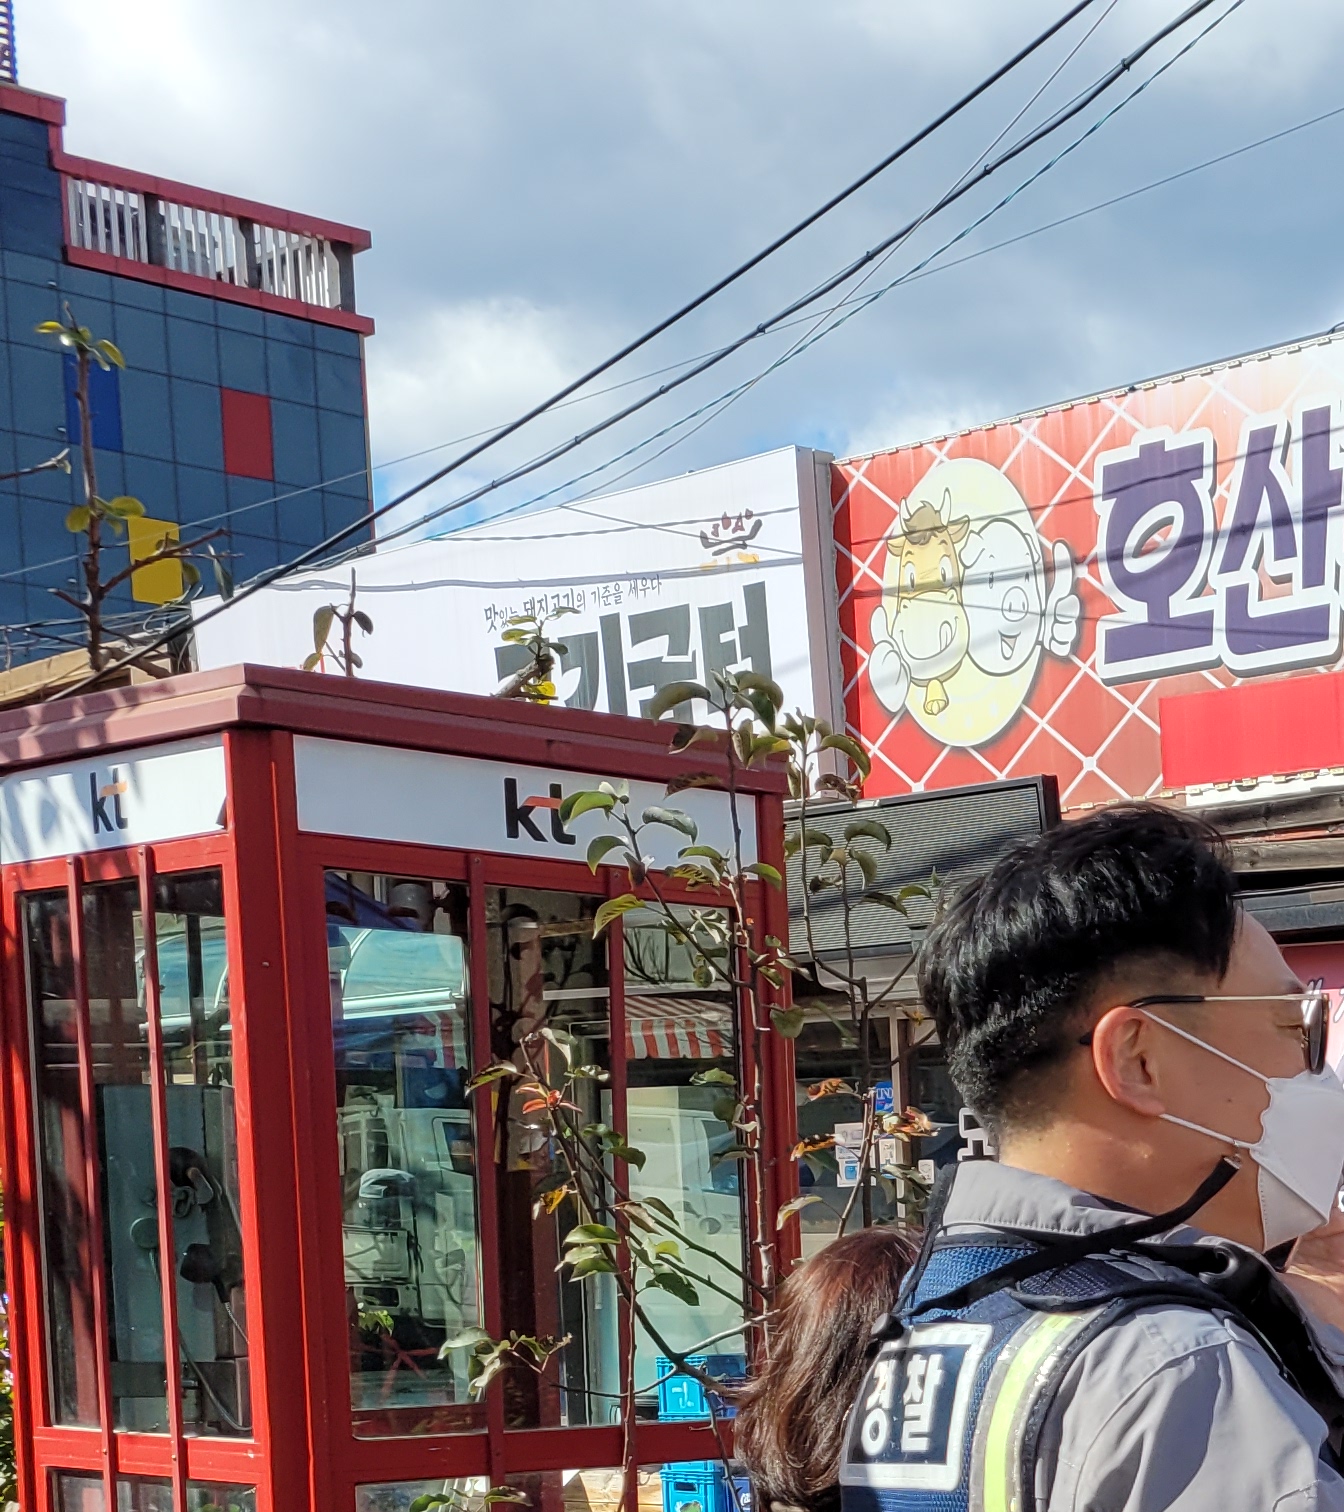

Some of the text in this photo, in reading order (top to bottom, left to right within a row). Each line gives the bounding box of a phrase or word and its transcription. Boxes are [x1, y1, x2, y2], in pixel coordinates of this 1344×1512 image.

[591, 582, 623, 607] 기준을
[628, 574, 663, 599] 세우다
[90, 767, 129, 835] kt
[505, 777, 577, 845] kt
[860, 1353, 947, 1457] 경찰
